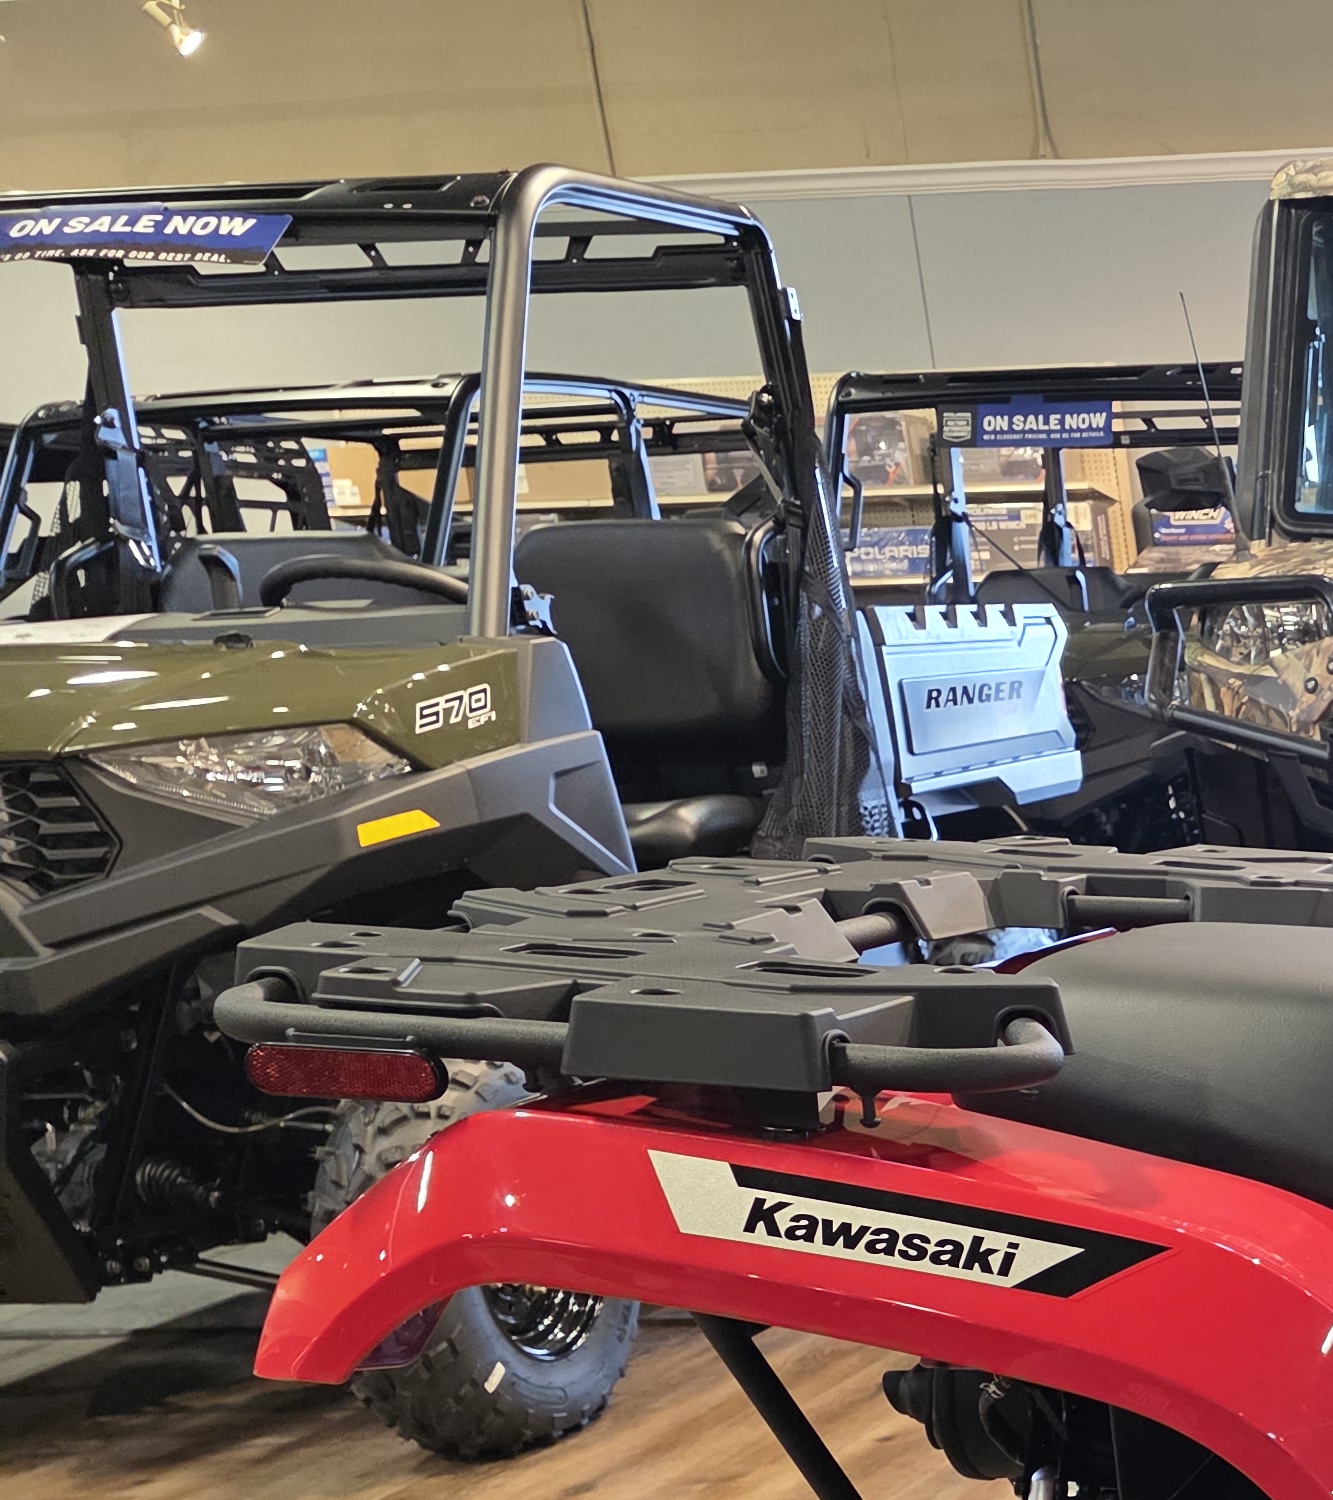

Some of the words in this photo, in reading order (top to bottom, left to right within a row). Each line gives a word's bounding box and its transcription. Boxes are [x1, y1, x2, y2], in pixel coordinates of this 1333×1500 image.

[9, 217, 62, 238] ON
[63, 214, 163, 234] SALE
[163, 216, 258, 236] NOW
[34, 249, 65, 258] TIME.
[70, 248, 96, 257] ASK
[99, 249, 125, 258] FOR
[128, 250, 155, 260] OUR
[158, 252, 191, 262] BEST
[194, 252, 231, 263] DEAL.
[983, 415, 1009, 431] ON
[1012, 414, 1061, 431] SALE
[1065, 412, 1107, 430] NOW
[1174, 507, 1222, 520] WINCH
[845, 545, 930, 560] POLARIS
[924, 680, 1024, 710] RANGER
[415, 683, 491, 734] 570
[742, 1196, 1020, 1278] Kawasaki
